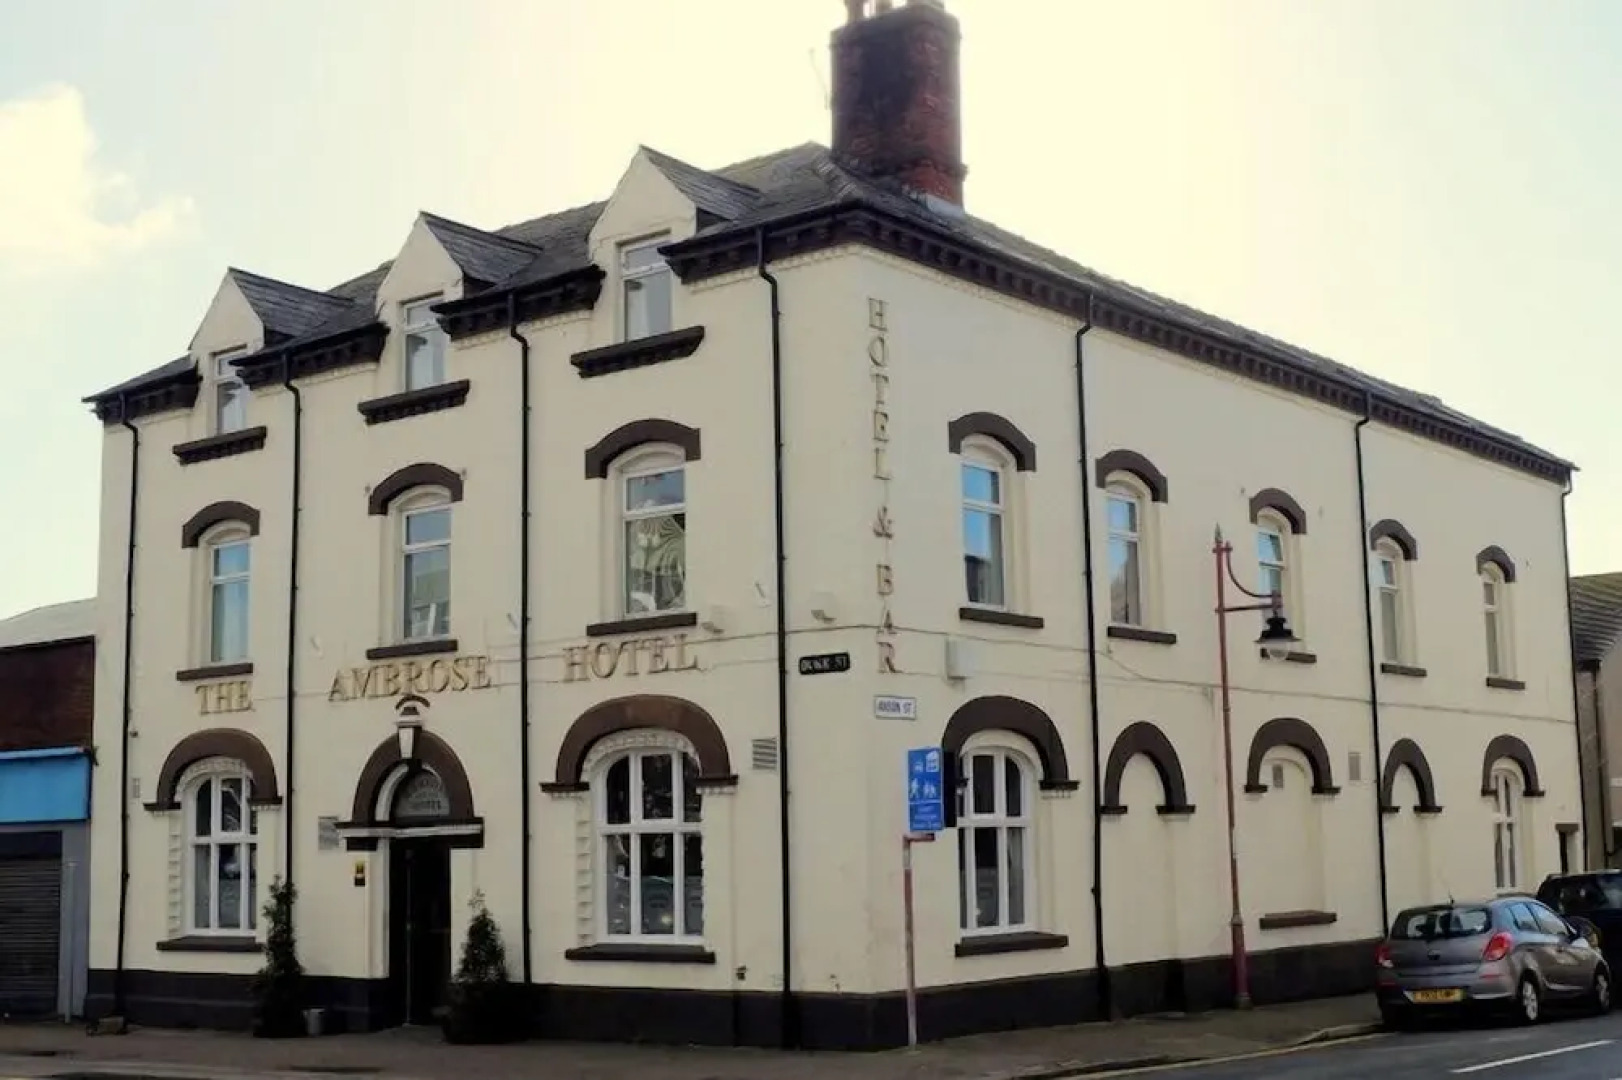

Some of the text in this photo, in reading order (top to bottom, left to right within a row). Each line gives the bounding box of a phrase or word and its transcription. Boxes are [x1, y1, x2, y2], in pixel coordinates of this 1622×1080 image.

[868, 298, 902, 673] HOTEL & BAR
[195, 634, 701, 715] THE AMBROSE HOTEL
